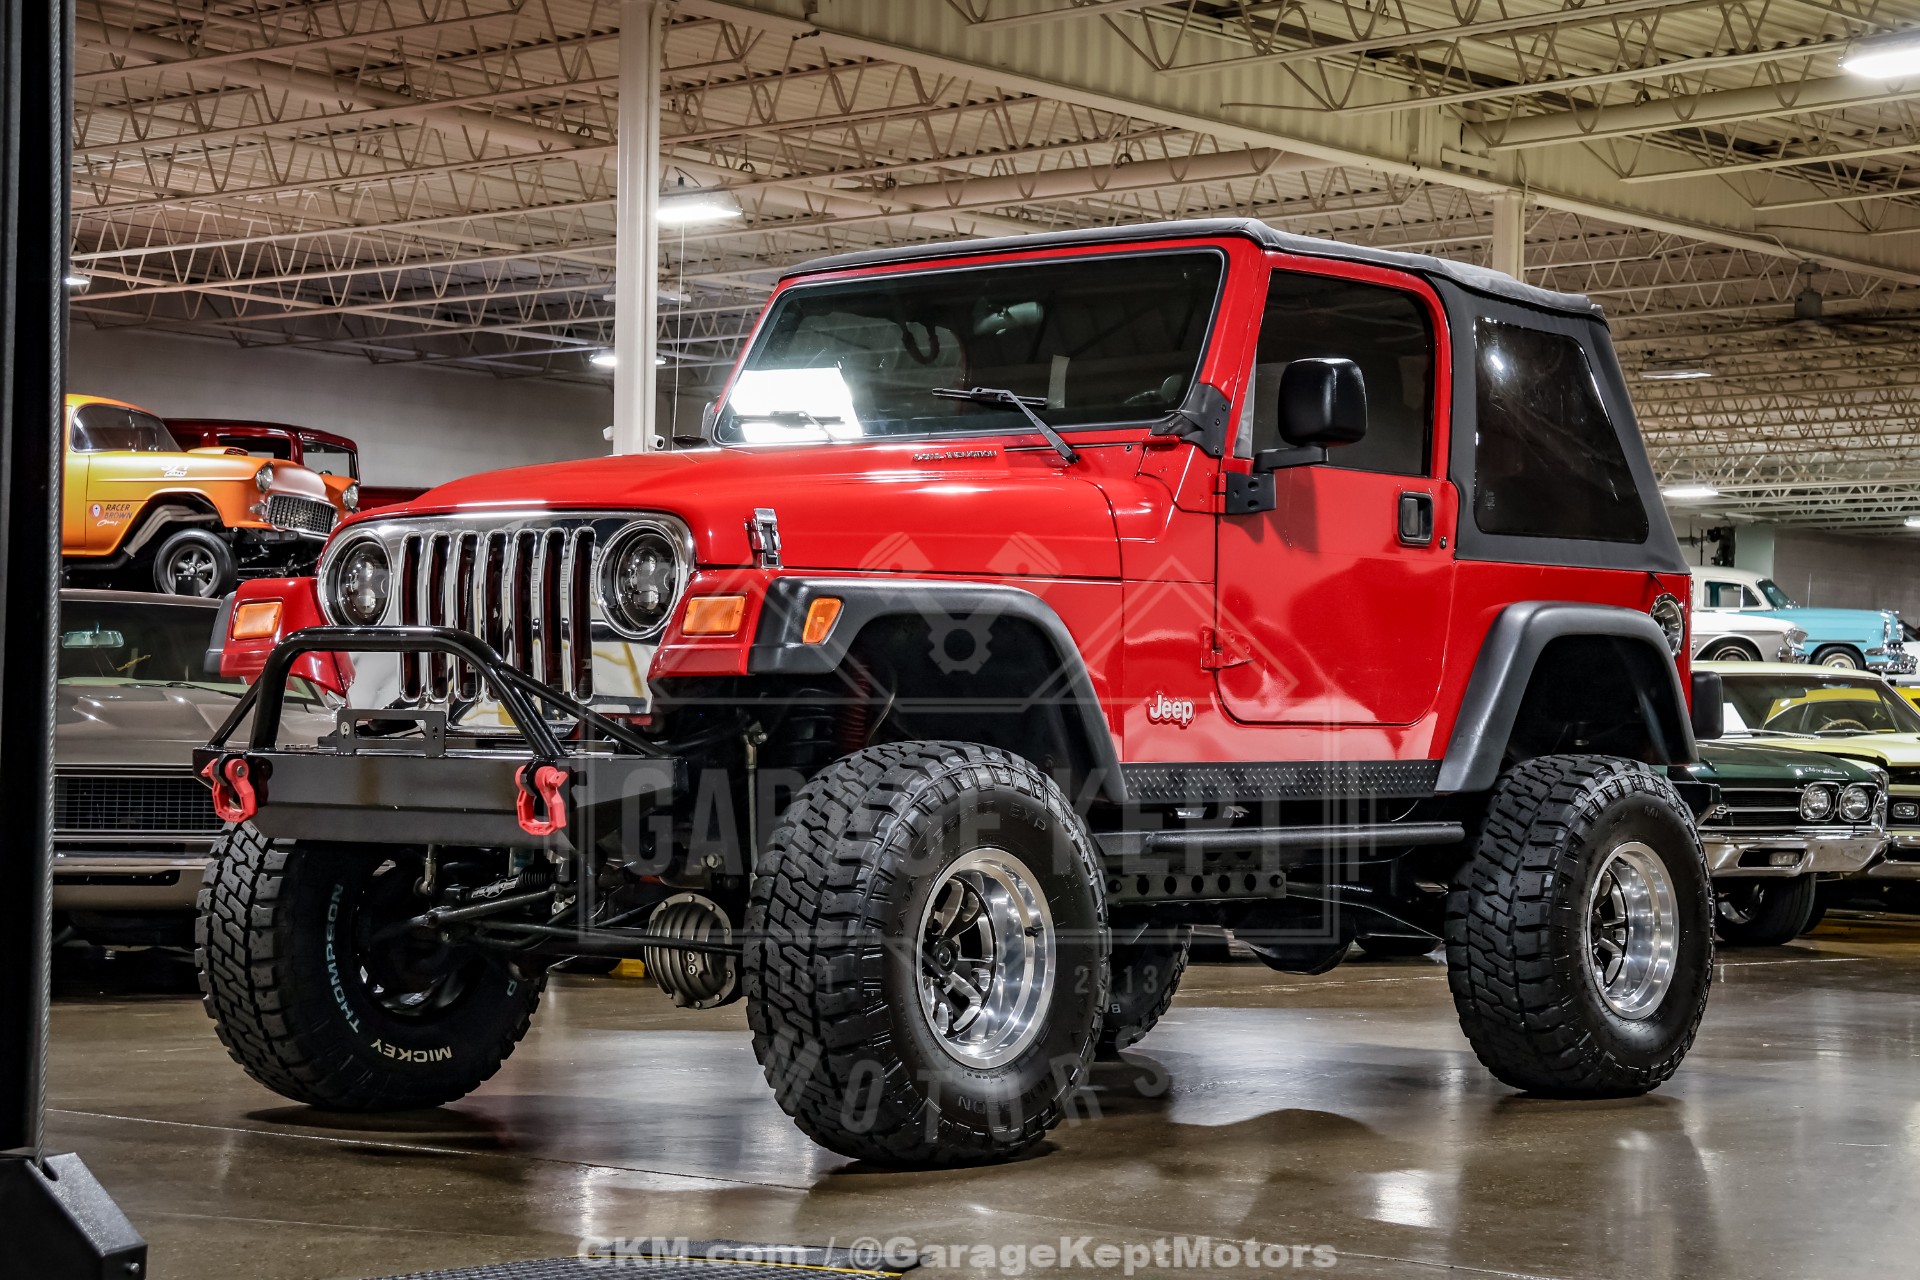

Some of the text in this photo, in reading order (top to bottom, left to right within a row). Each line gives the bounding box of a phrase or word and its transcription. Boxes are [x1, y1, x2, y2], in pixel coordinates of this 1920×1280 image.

[104, 511, 133, 519] BROWN
[105, 503, 131, 511] RACER
[1149, 693, 1194, 725] Jeep
[325, 883, 361, 1034] THOMPSON
[370, 1037, 453, 1063] MICKEY
